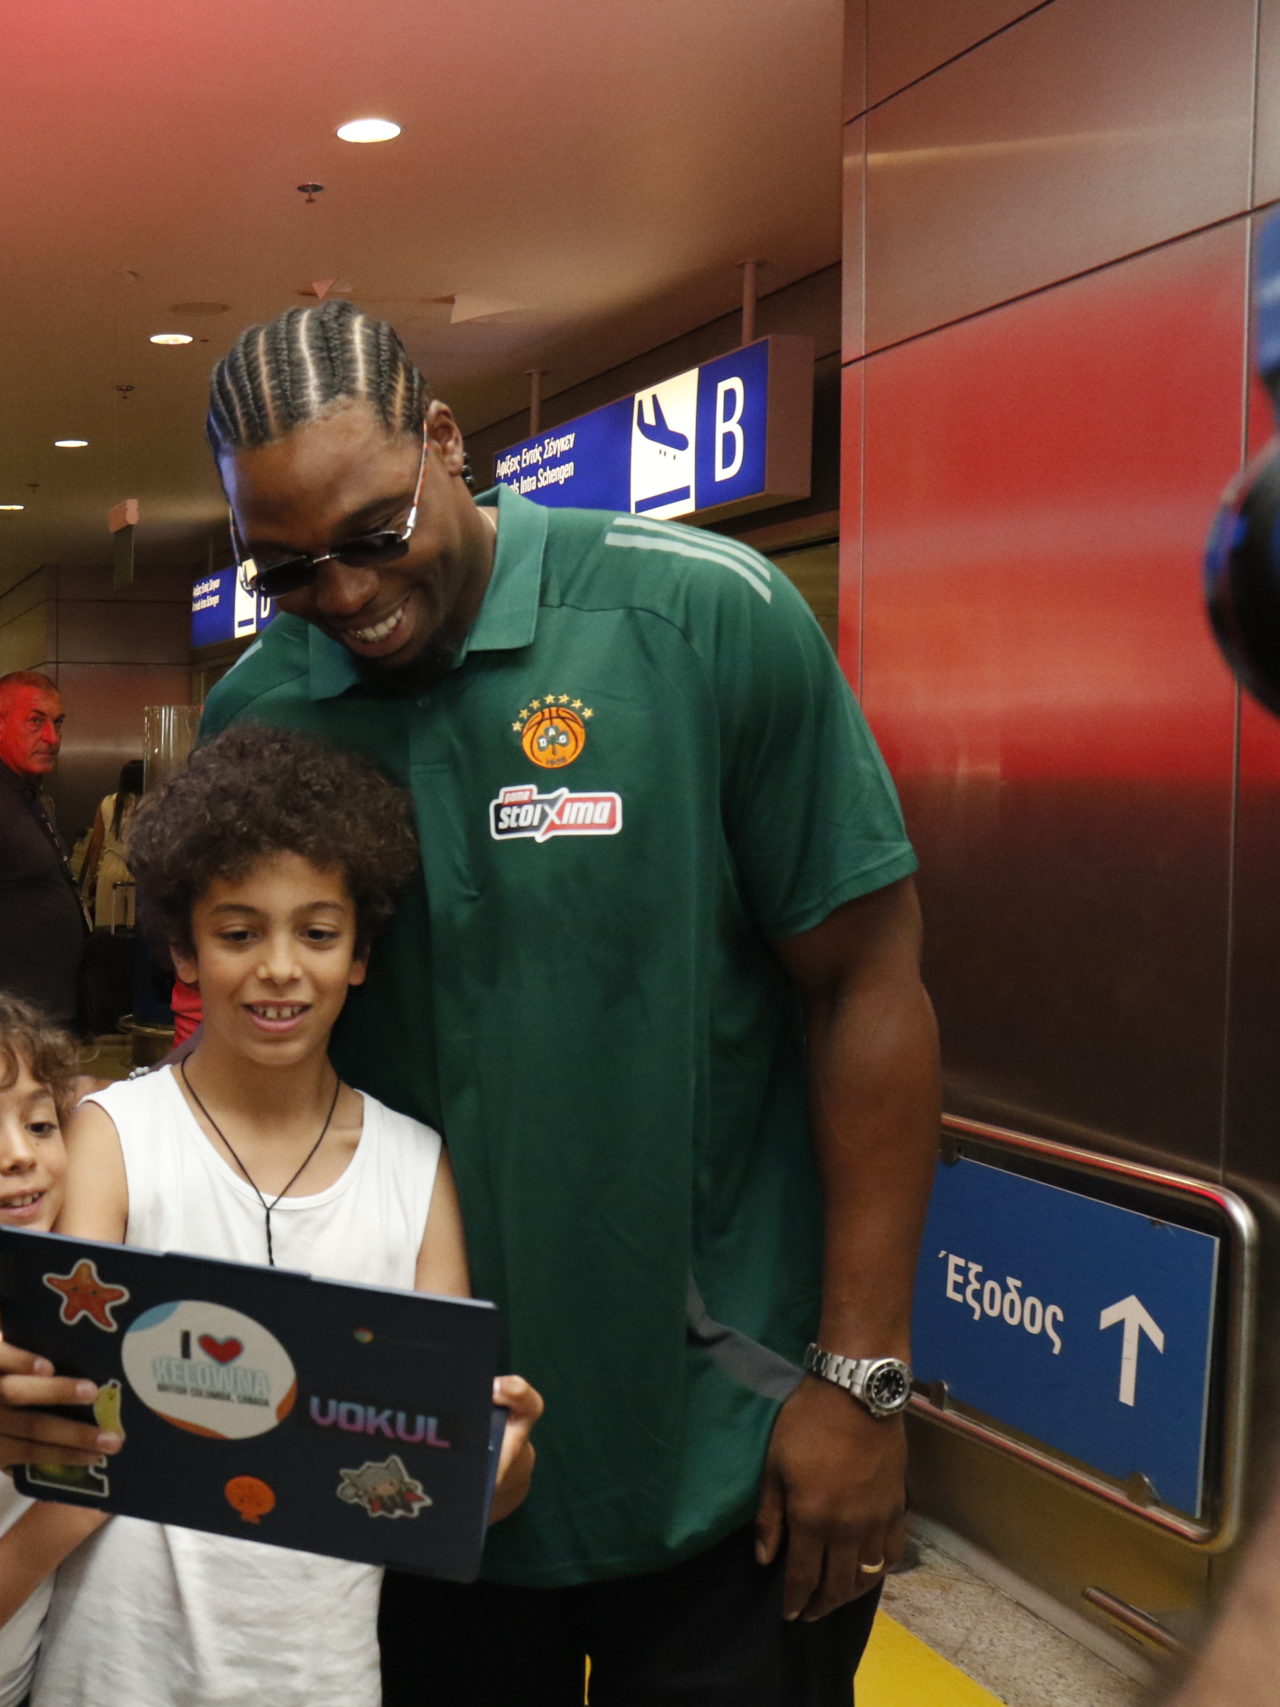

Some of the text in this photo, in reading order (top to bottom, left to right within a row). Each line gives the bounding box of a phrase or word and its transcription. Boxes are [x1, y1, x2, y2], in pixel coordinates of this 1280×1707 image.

[713, 376, 744, 483] B
[520, 475, 537, 495] Intra
[537, 461, 575, 485] Schengen
[938, 1250, 1064, 1355] Έξοδος
[181, 1330, 191, 1359] I
[152, 1357, 271, 1399] KELOWNA
